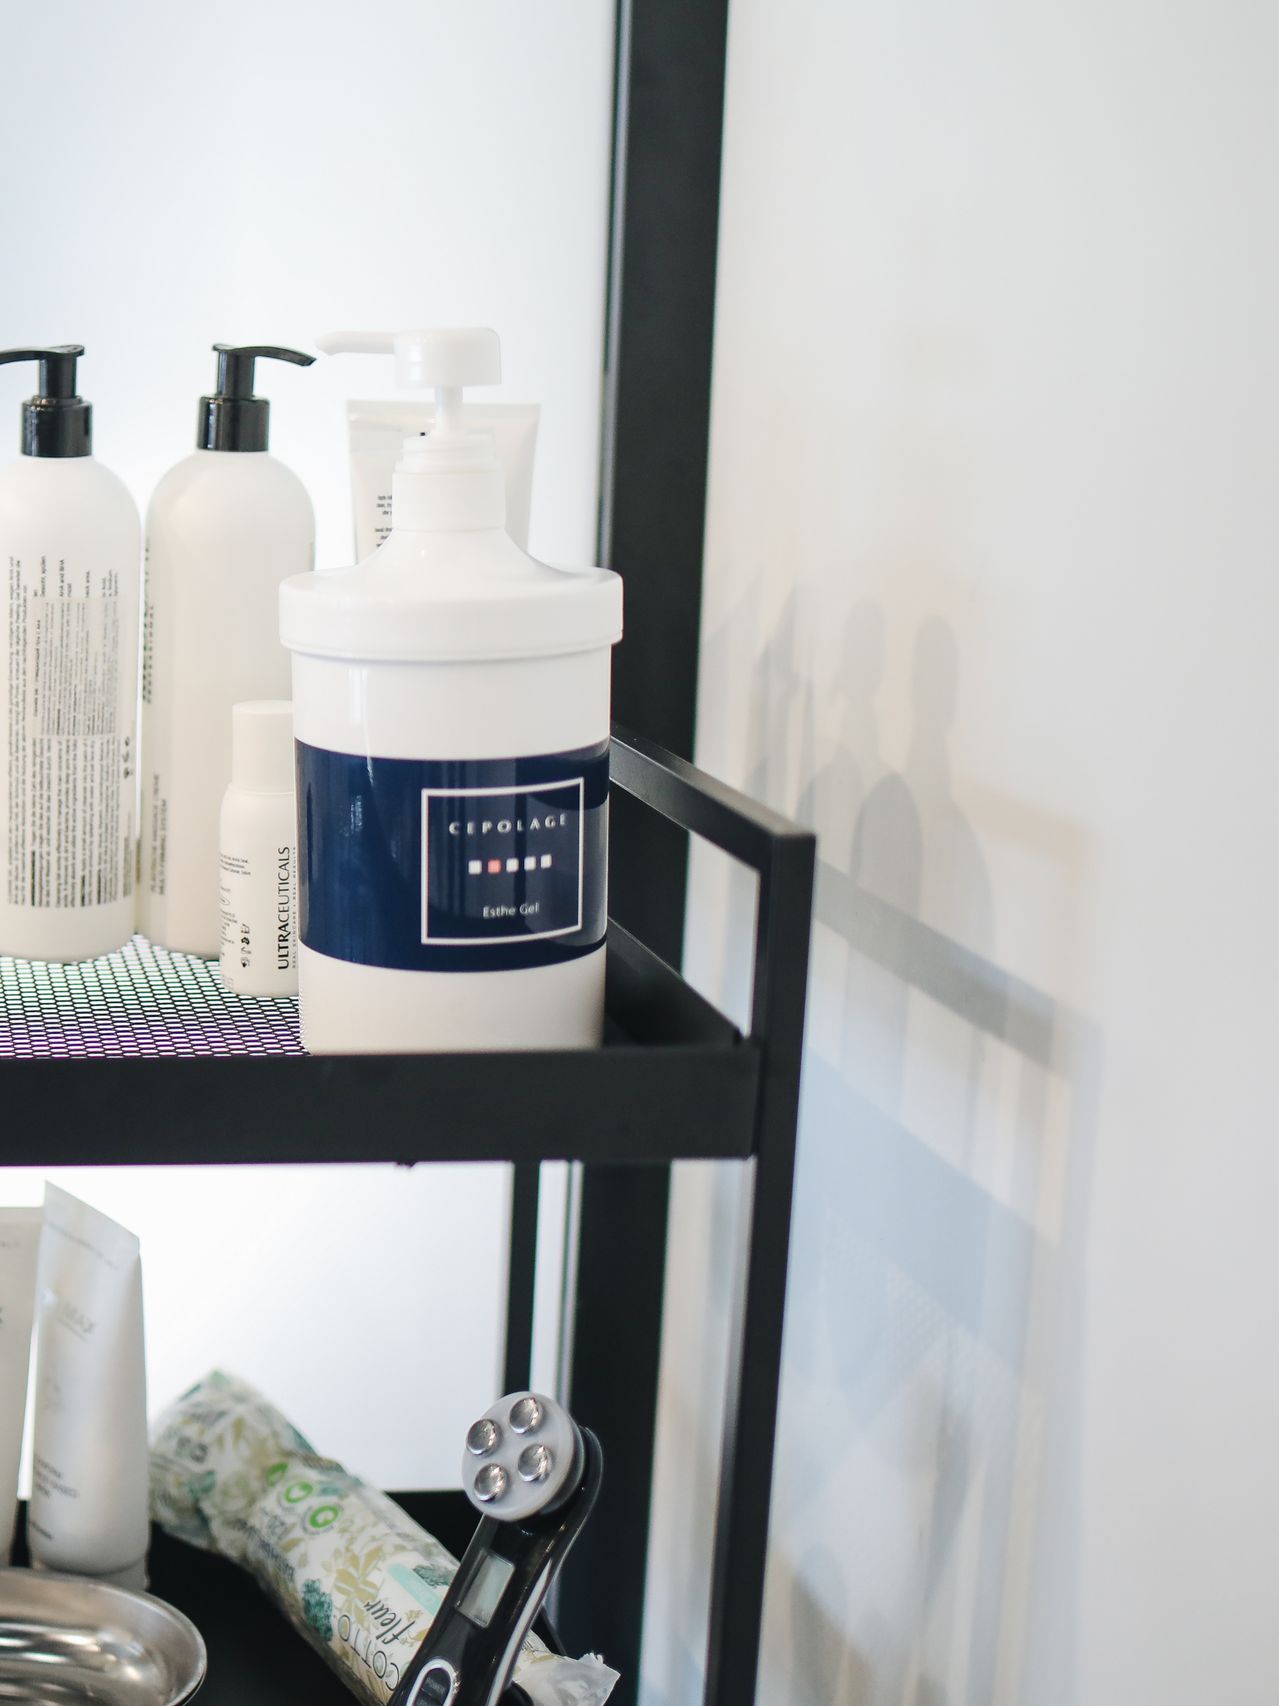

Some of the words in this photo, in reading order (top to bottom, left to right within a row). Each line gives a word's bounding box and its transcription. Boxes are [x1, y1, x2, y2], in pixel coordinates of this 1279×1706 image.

[449, 813, 567, 834] CEPOLAGE
[278, 846, 290, 970] ULTRACEUTICALS
[483, 904, 516, 918] Esthe
[520, 902, 540, 914] Gel
[364, 1600, 416, 1645] fleur
[338, 1614, 400, 1691] COTTO
